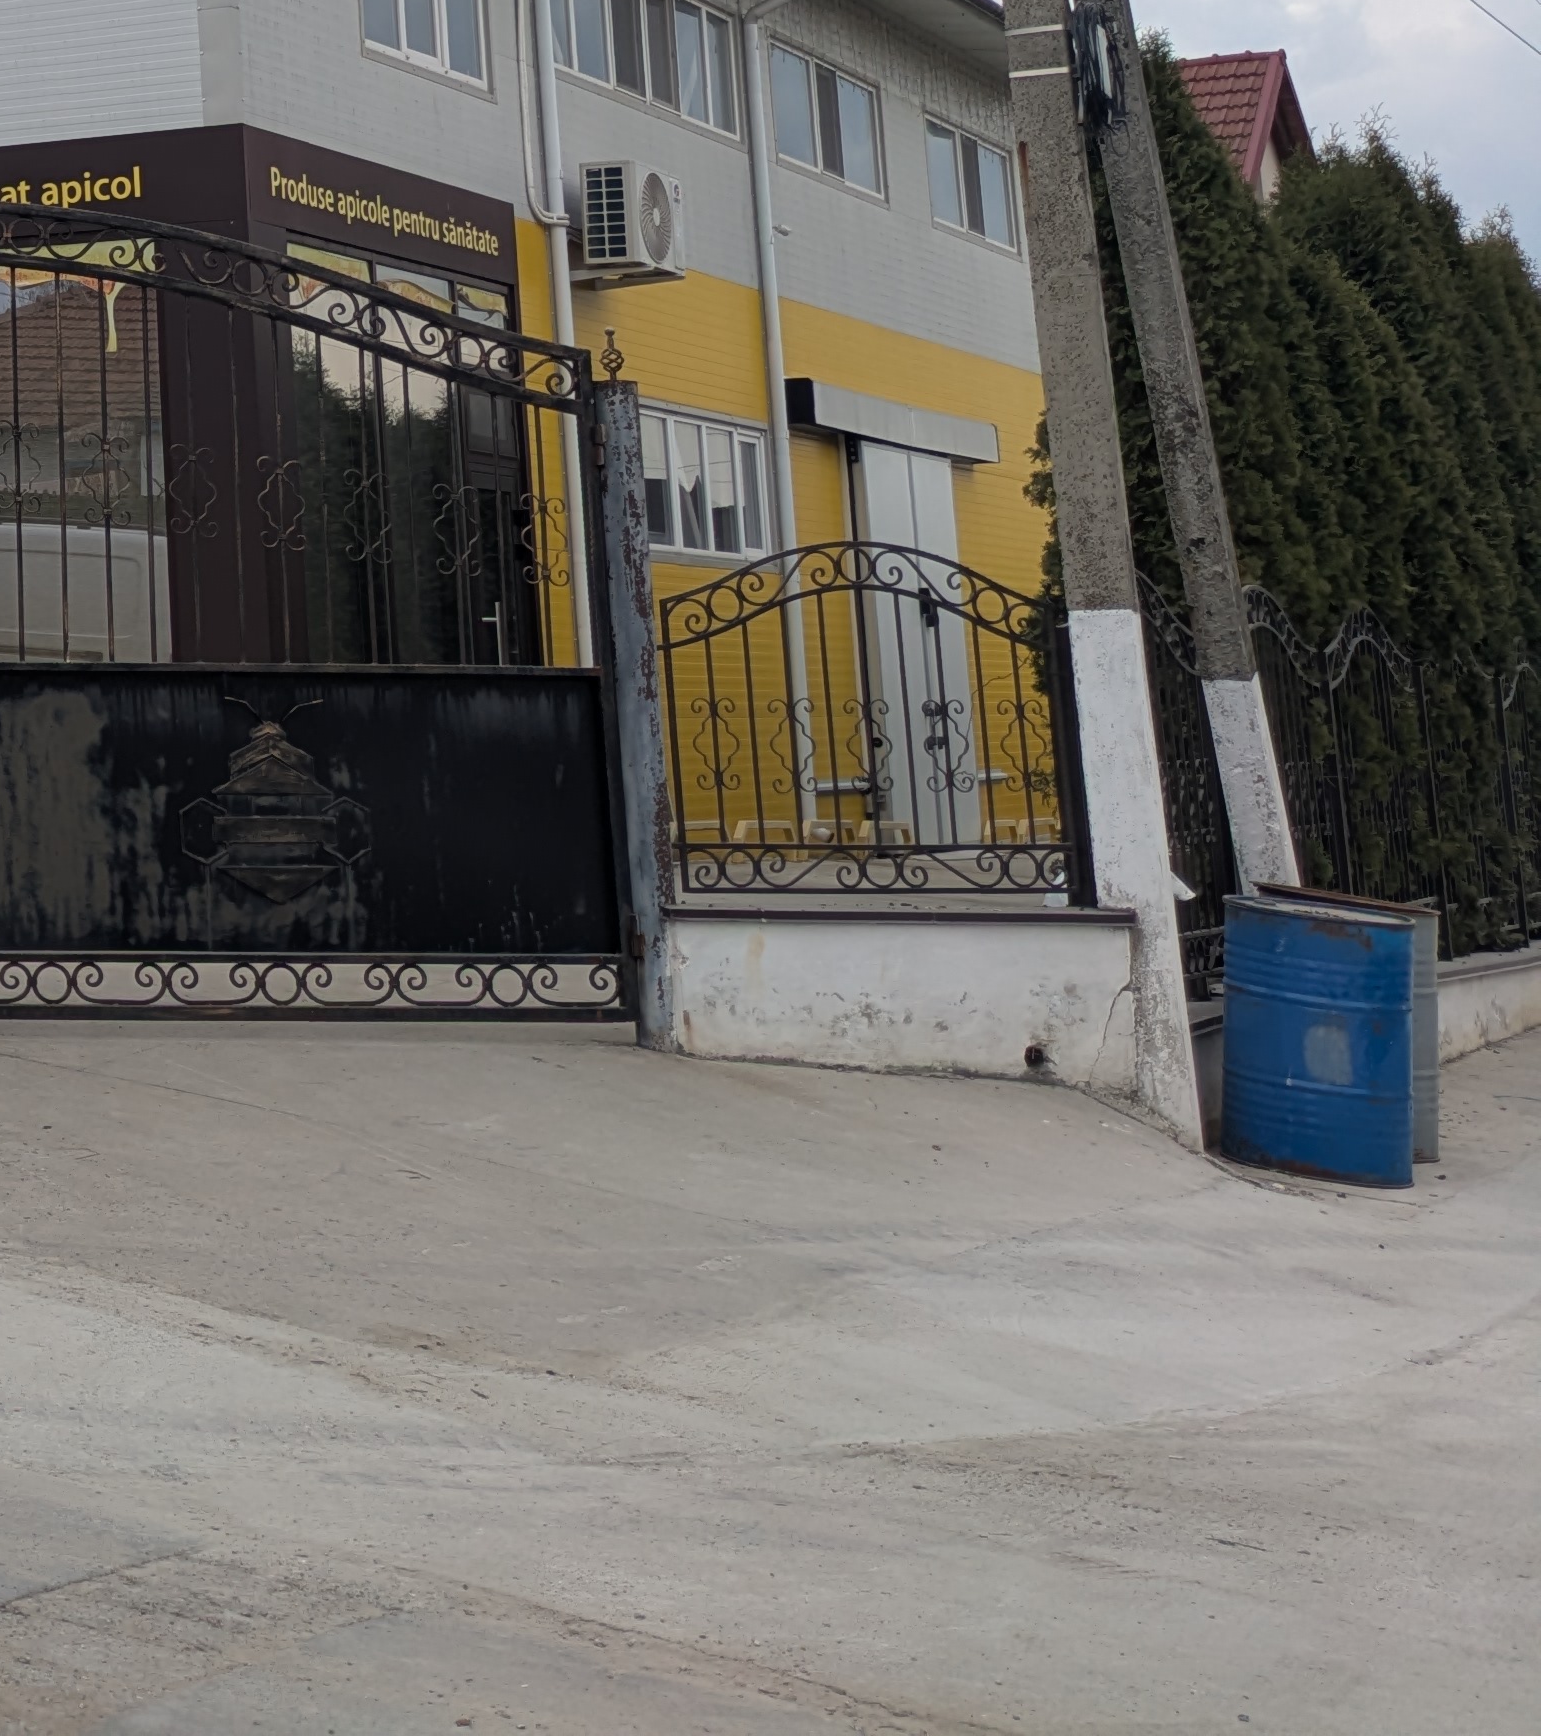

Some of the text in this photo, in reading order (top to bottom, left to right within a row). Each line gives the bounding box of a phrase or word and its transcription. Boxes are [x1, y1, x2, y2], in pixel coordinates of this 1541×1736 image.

[41, 165, 141, 209] apicol
[270, 166, 499, 257] Produse apicole pentru sănătate
